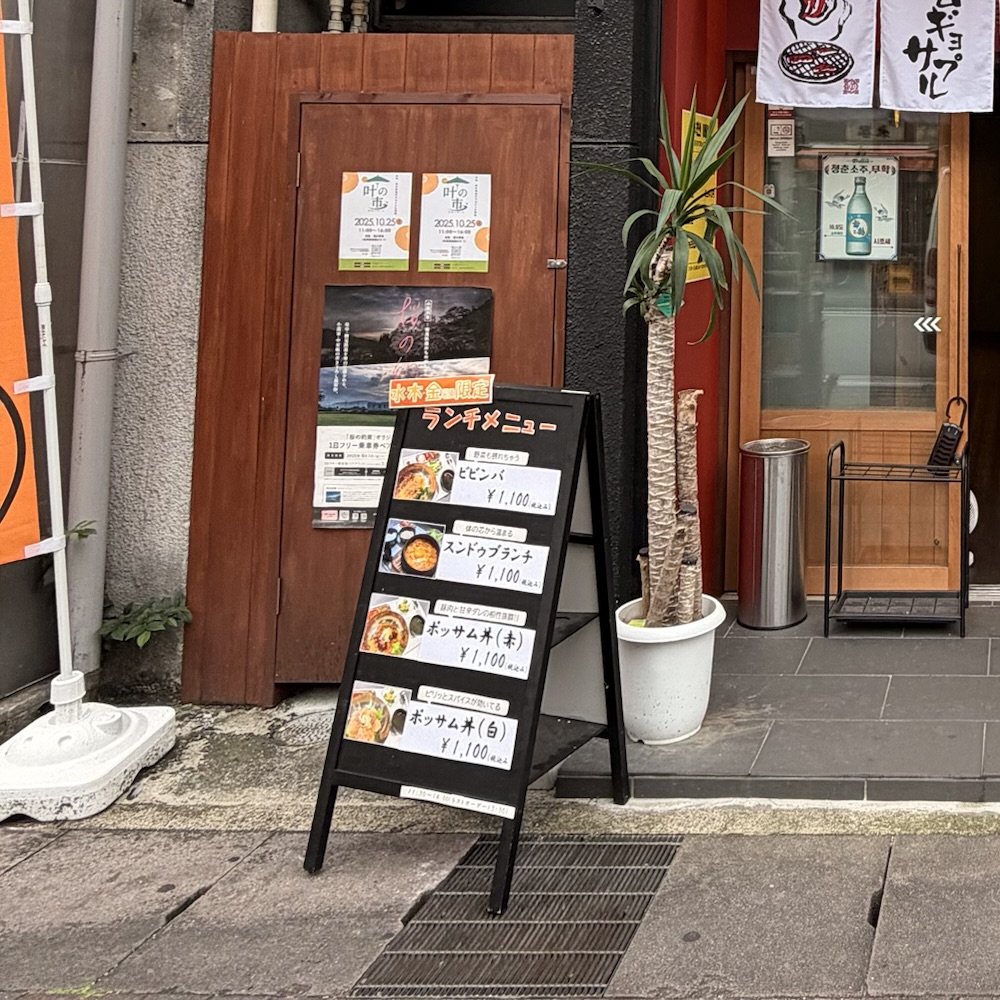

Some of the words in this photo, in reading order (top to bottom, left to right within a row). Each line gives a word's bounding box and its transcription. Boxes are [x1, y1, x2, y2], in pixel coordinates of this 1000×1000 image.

[354, 217, 396, 227] 2025.10.25
[434, 219, 476, 228] 2025.10.25
[422, 406, 557, 435] ランチメニュー
[458, 466, 505, 481] ビビンバ
